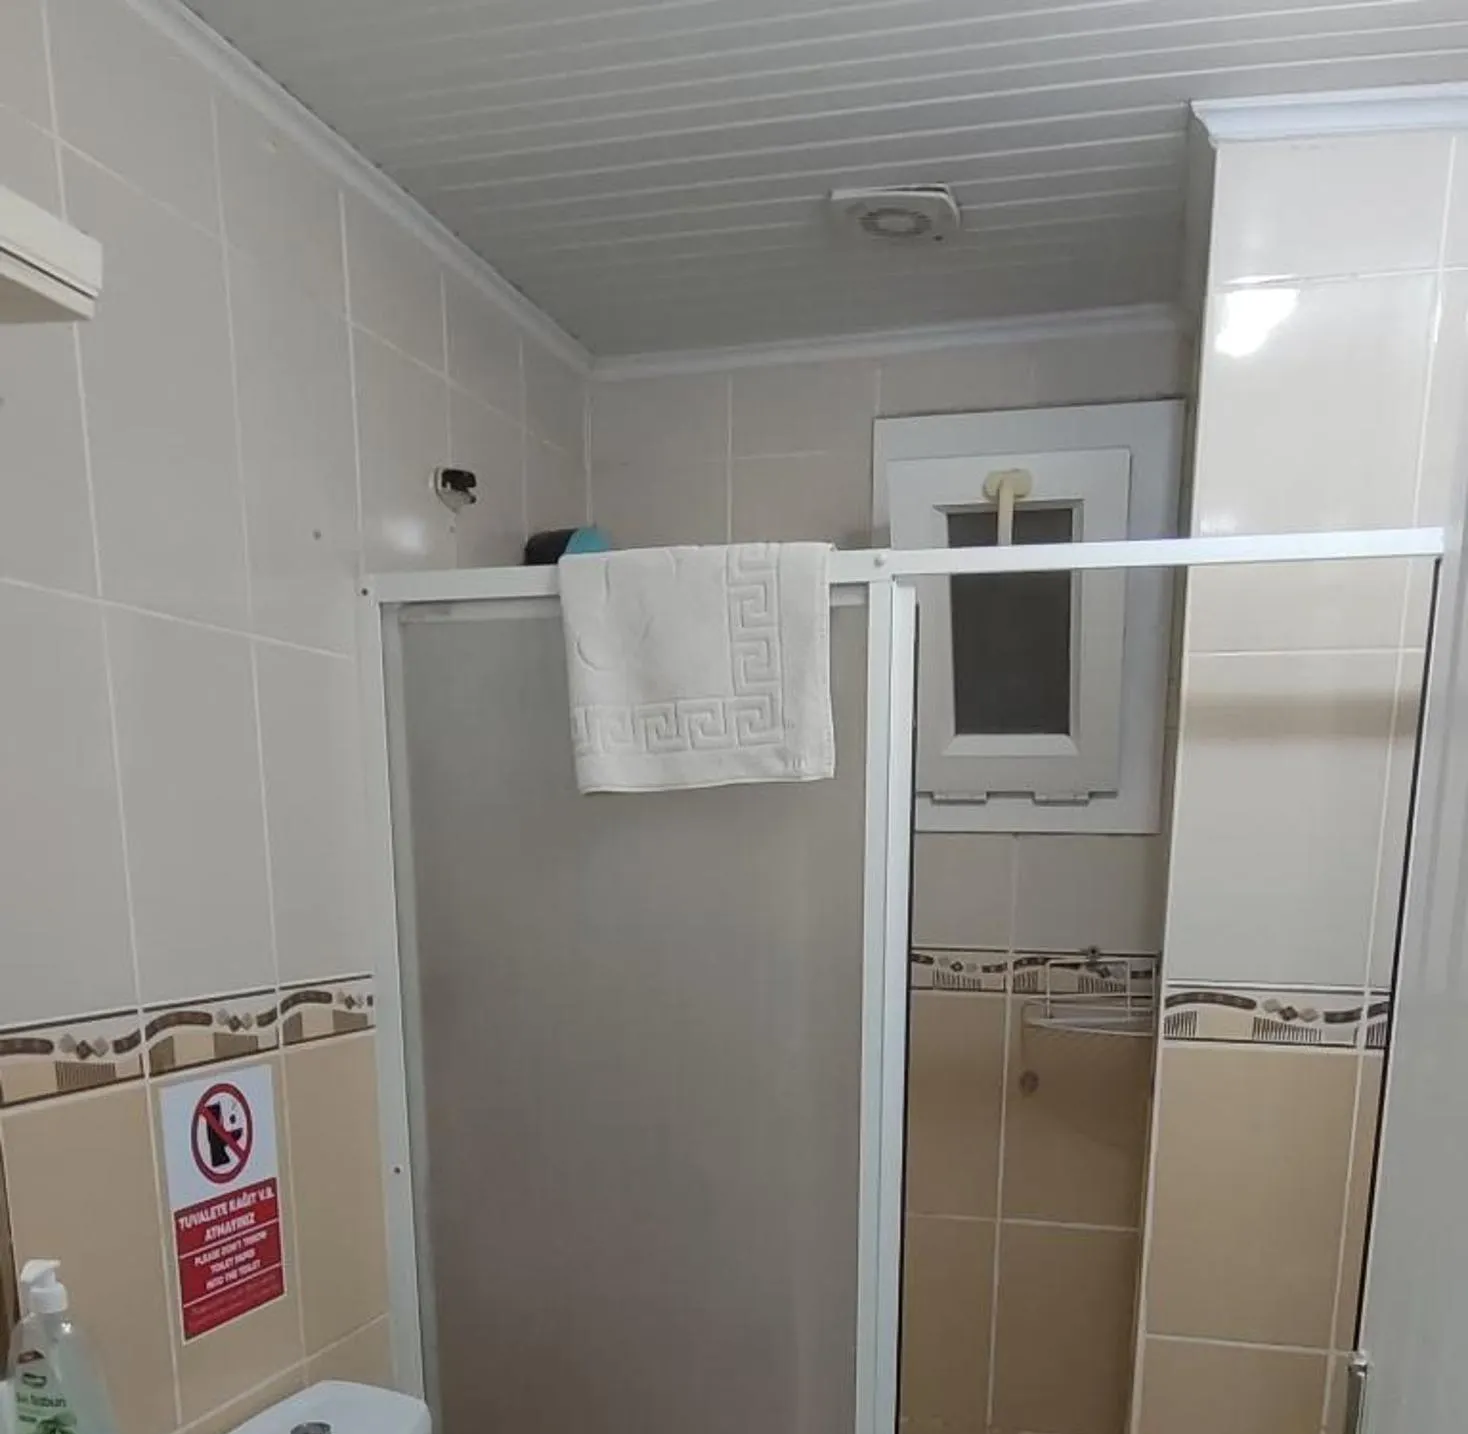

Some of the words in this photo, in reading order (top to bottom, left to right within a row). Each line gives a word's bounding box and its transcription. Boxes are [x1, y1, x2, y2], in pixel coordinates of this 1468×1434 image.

[178, 1202, 228, 1231] TUVALETE
[204, 1212, 256, 1241] ATMAYINIZ
[194, 1248, 221, 1267] PLEASE
